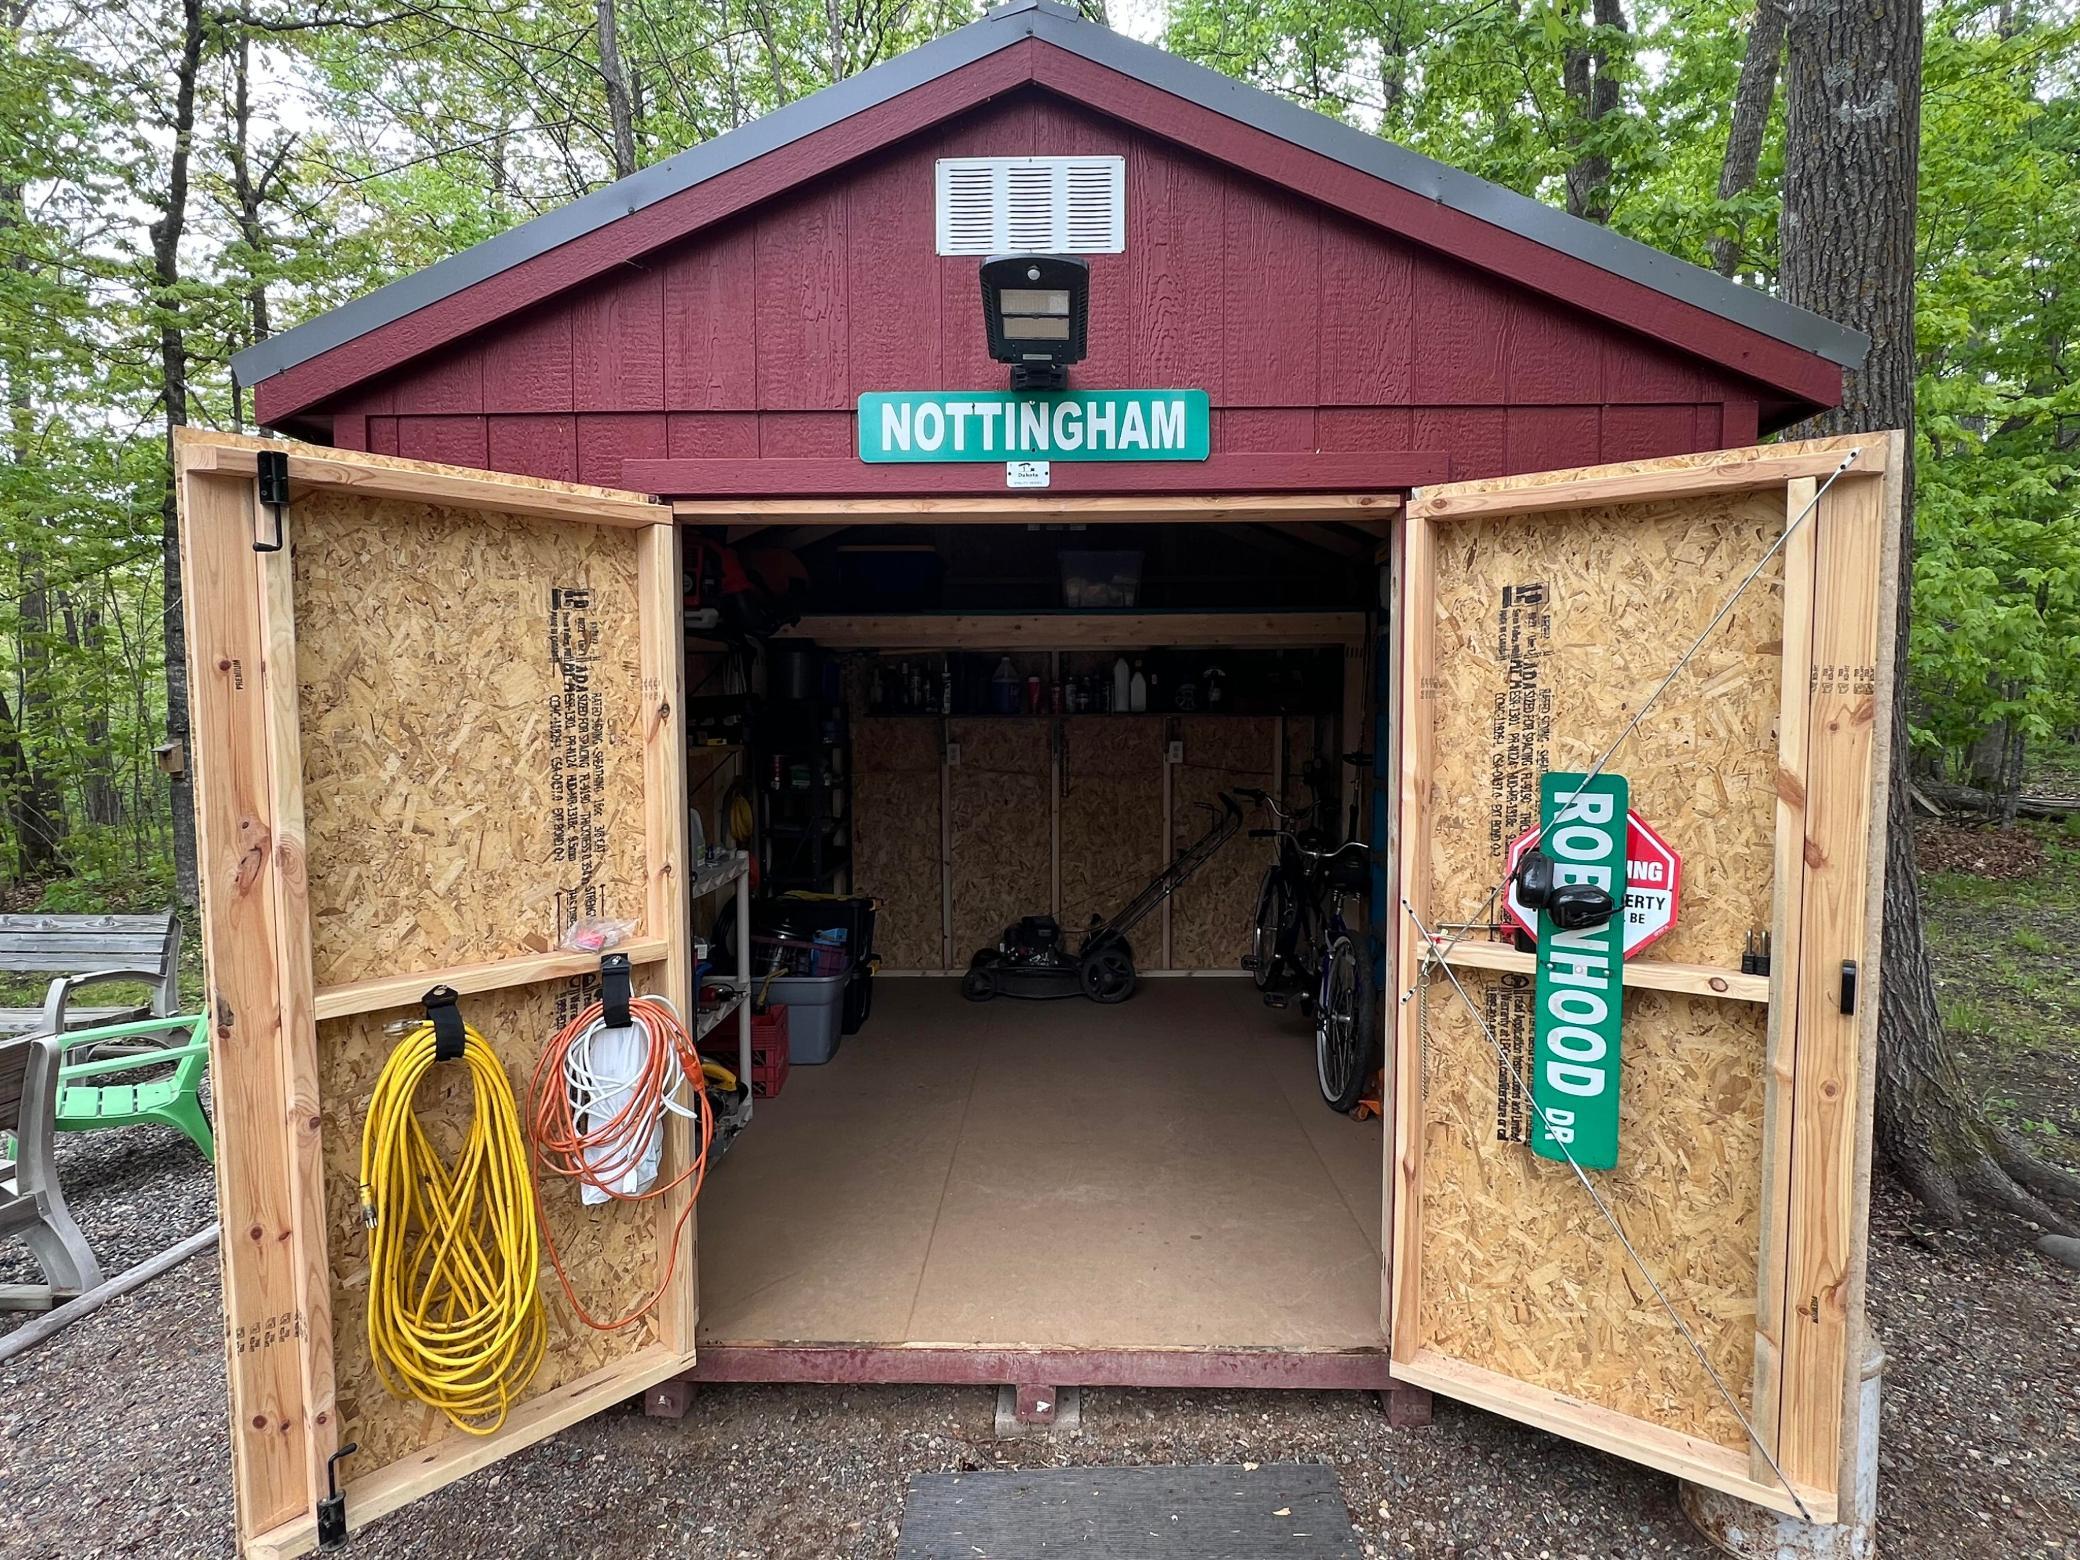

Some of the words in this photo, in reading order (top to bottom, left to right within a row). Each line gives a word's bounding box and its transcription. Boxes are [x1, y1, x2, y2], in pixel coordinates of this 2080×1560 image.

[881, 401, 1185, 451] NOTTINGHAM
[232, 660, 244, 690] PREMIUM
[565, 693, 576, 729] ESR-1301
[578, 694, 590, 716] SIZED
[592, 693, 602, 716] RATED
[1509, 691, 1520, 726] ESR-1301
[1523, 690, 1535, 714] SIZED
[578, 718, 589, 733] FOR
[592, 719, 603, 744] SIDING
[1522, 715, 1535, 731] FOR
[579, 735, 590, 767] SPACING
[1522, 732, 1534, 766] SPACING
[1537, 750, 1549, 773] SHEAT
[1491, 804, 1502, 817] EXT
[581, 811, 591, 853] THICKNESS
[1491, 820, 1501, 841] BOND
[1625, 894, 1665, 910] ERTY
[1630, 913, 1646, 924] BE
[1546, 792, 1614, 1097] ROBNHOOD
[1498, 993, 1512, 1027] Warranty
[1500, 1029, 1510, 1037] at
[1512, 1014, 1525, 1053] Application
[1512, 1101, 1521, 1114] and
[1545, 1108, 1575, 1143] DR
